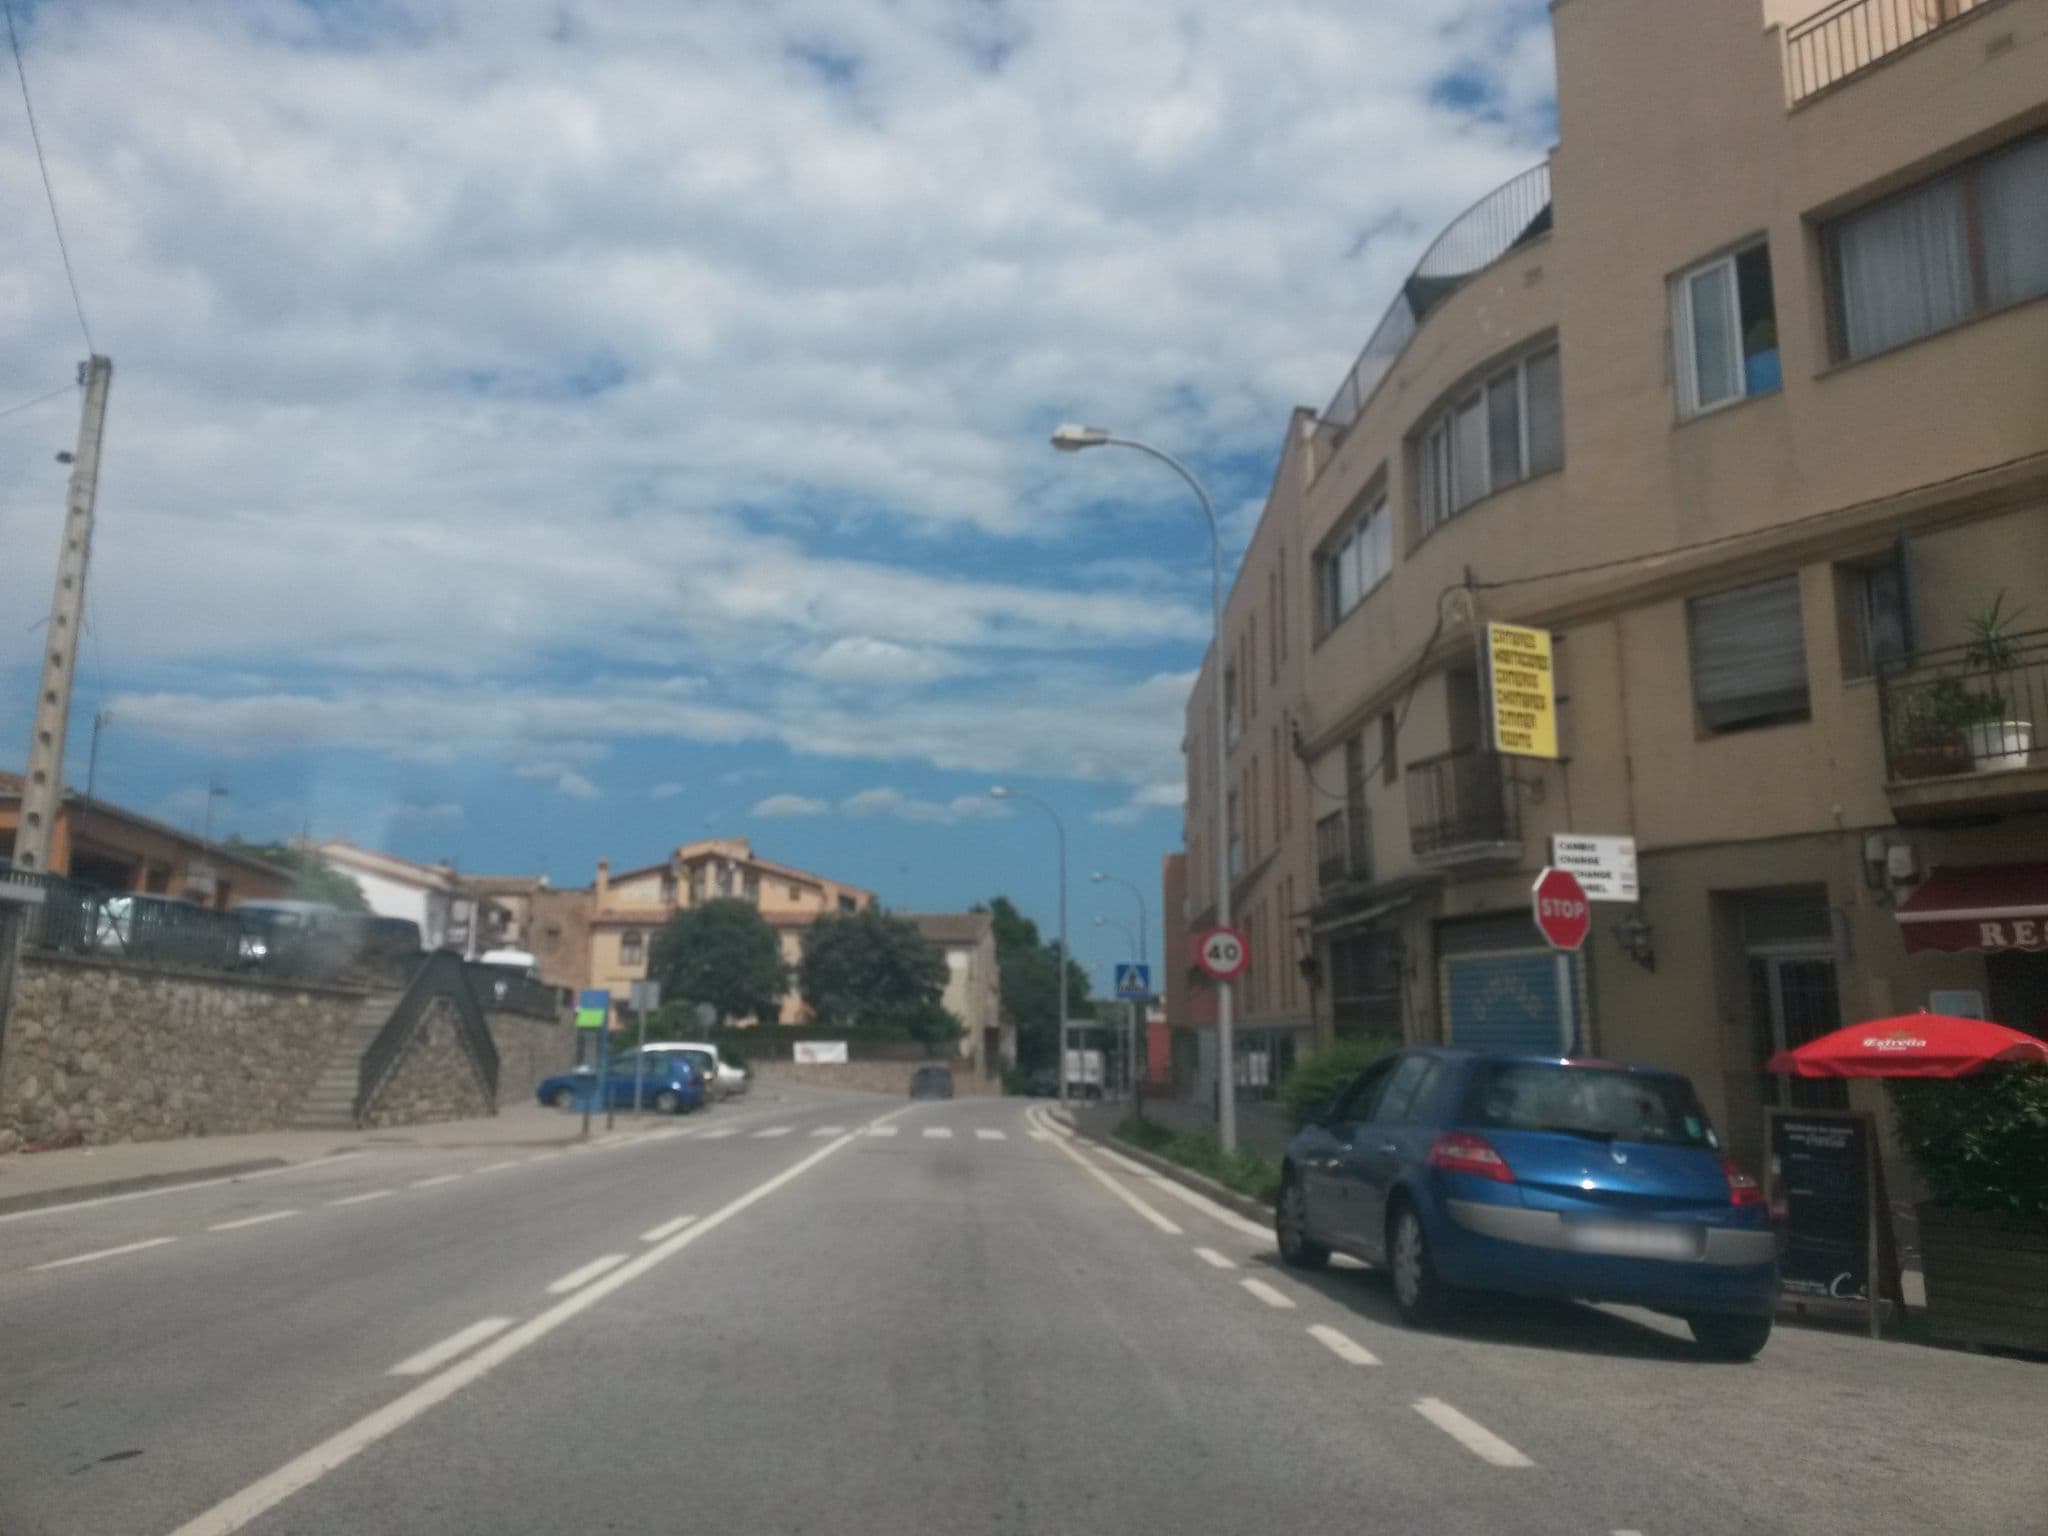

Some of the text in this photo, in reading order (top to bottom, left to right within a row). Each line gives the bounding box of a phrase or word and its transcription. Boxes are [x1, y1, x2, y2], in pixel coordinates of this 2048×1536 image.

[1560, 855, 1600, 865] CHANGE
[1541, 898, 1584, 920] STOP
[1980, 921, 2048, 946] RE
[1208, 943, 1239, 960] 40
